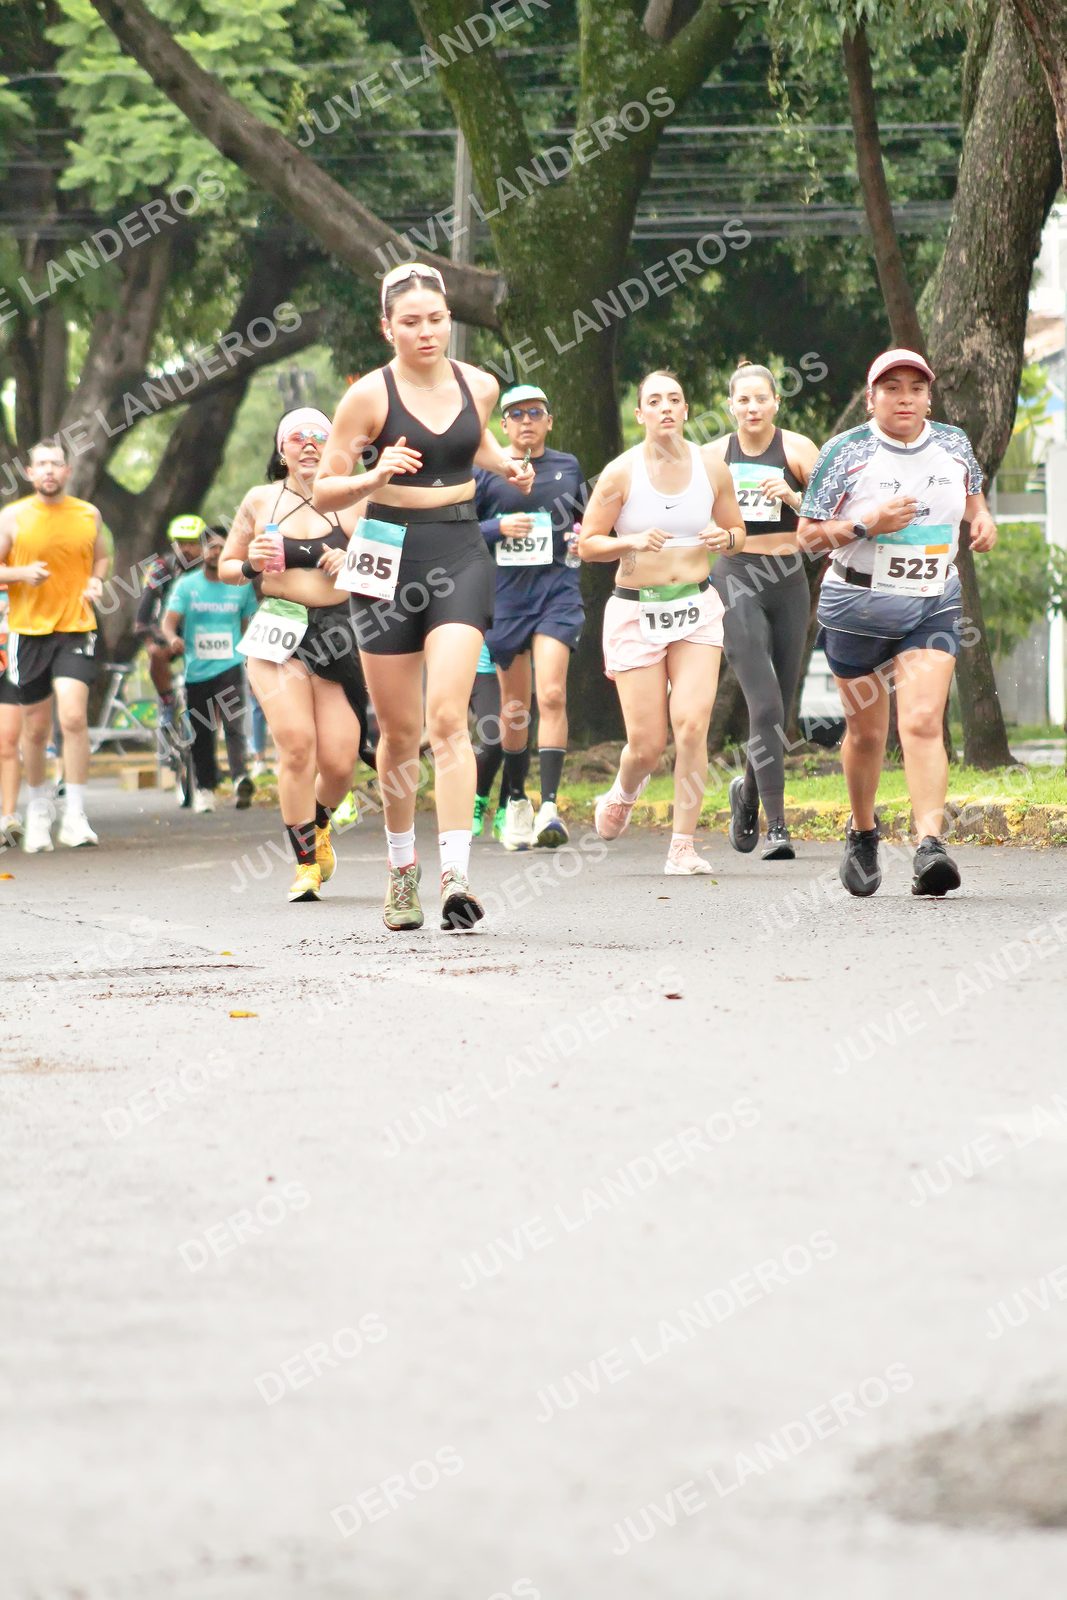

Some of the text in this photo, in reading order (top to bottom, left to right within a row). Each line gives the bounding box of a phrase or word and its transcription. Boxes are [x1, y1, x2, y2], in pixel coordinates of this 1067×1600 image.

[501, 537, 548, 553] 4597
[347, 550, 393, 580] 085
[887, 557, 939, 580] 523
[645, 607, 700, 630] 1979
[198, 639, 230, 651] 4309
[250, 624, 297, 650] 2100
